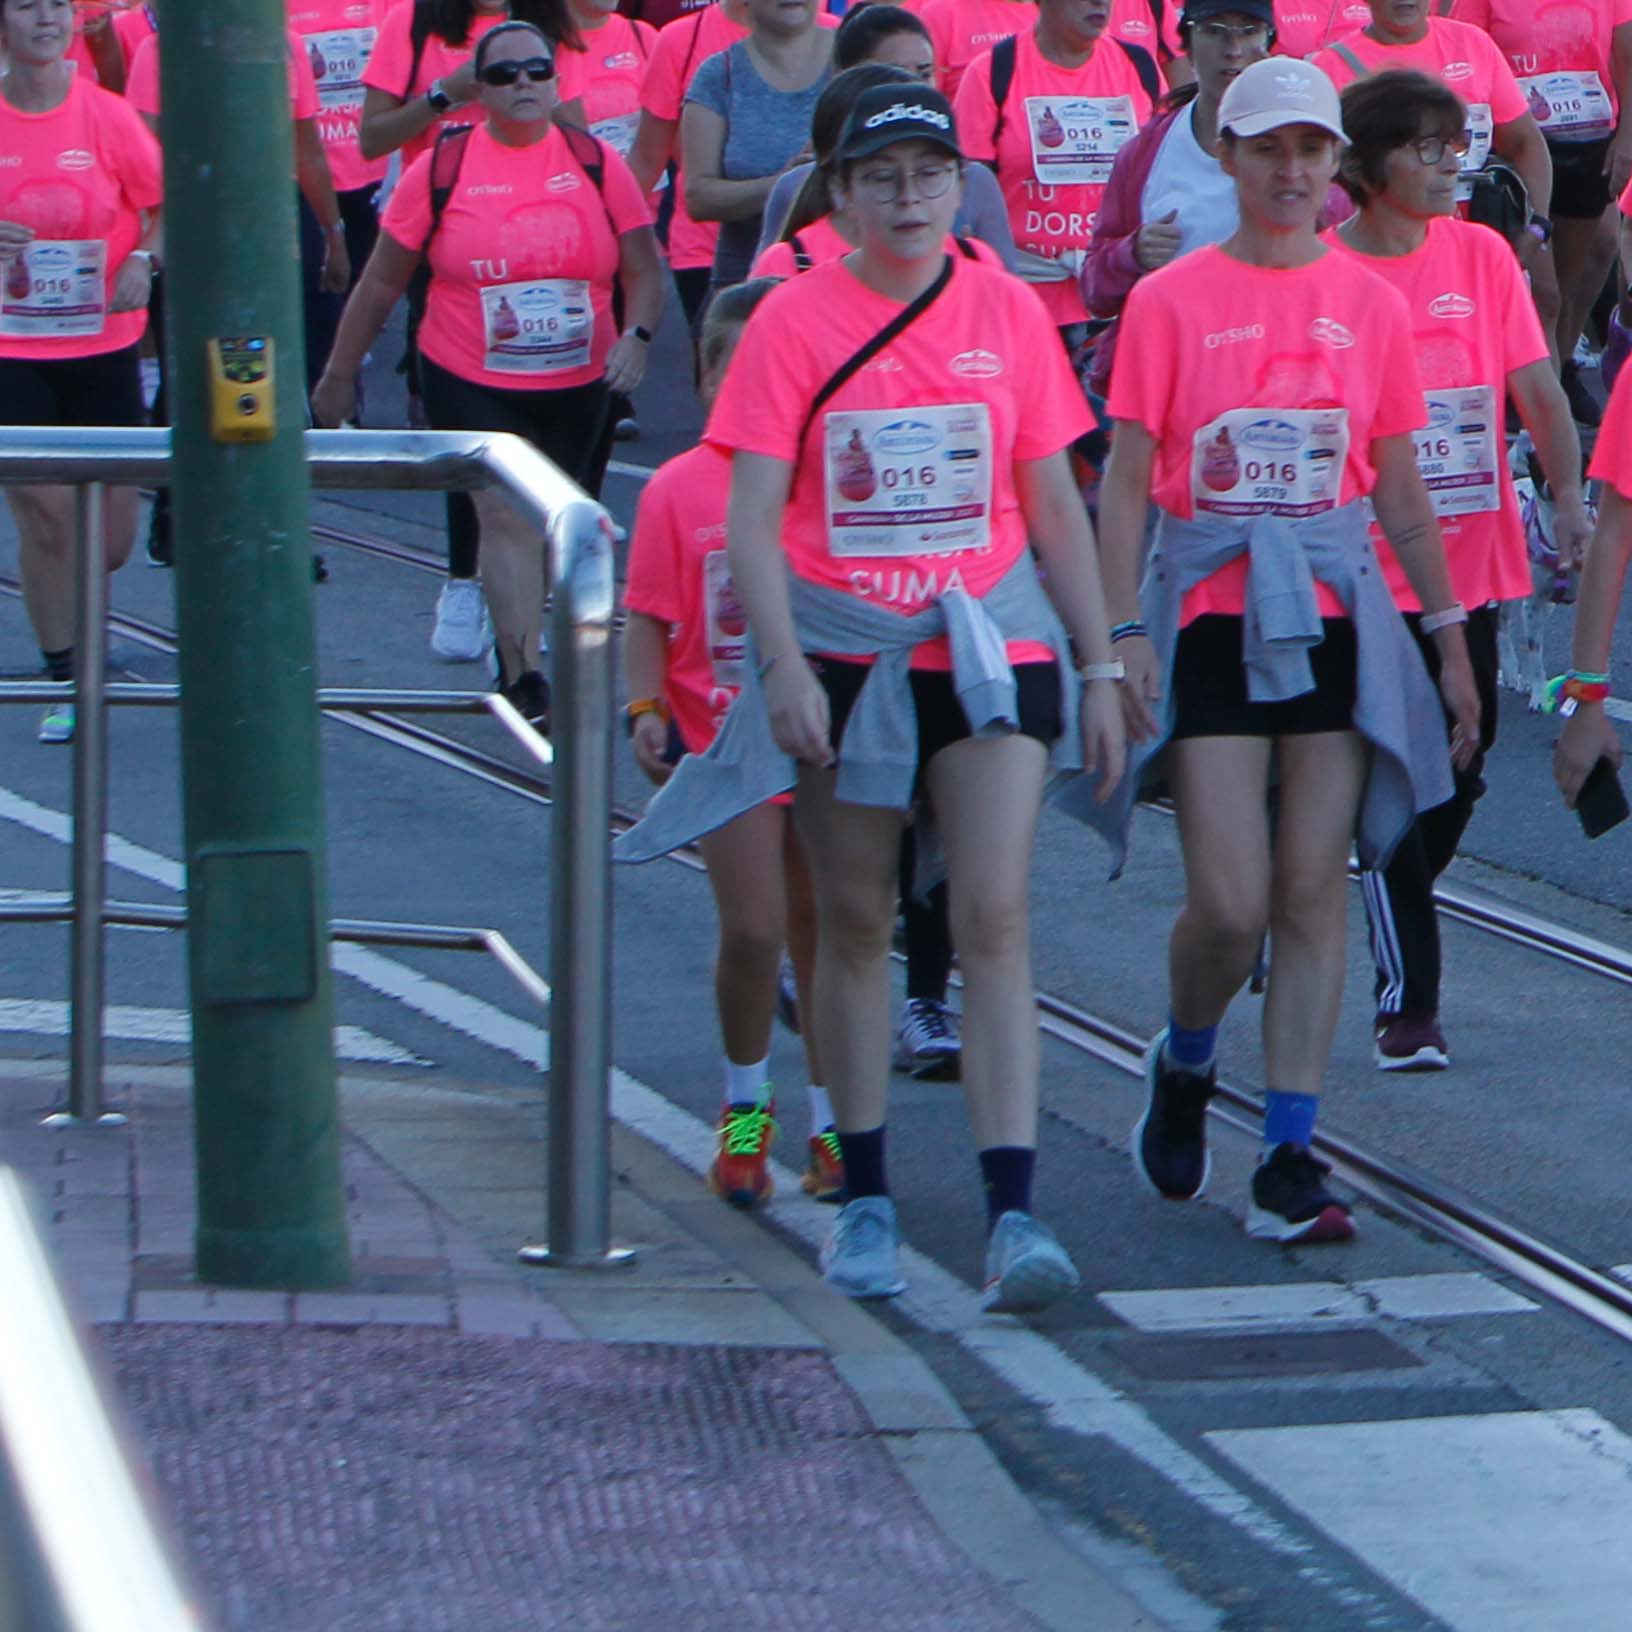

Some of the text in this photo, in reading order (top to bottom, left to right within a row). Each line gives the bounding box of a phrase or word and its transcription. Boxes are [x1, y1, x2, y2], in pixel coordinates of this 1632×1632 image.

[1512, 54, 1537, 72] TU
[1553, 99, 1581, 112] 016
[864, 103, 950, 129] adidas
[1067, 127, 1102, 140] 016
[1023, 180, 1055, 201] TU
[470, 259, 508, 279] TU
[522, 319, 558, 332] 016
[1204, 323, 1265, 349] OYSHO
[1413, 438, 1450, 457] 16
[882, 466, 936, 489] 016
[1245, 461, 1297, 482] 016
